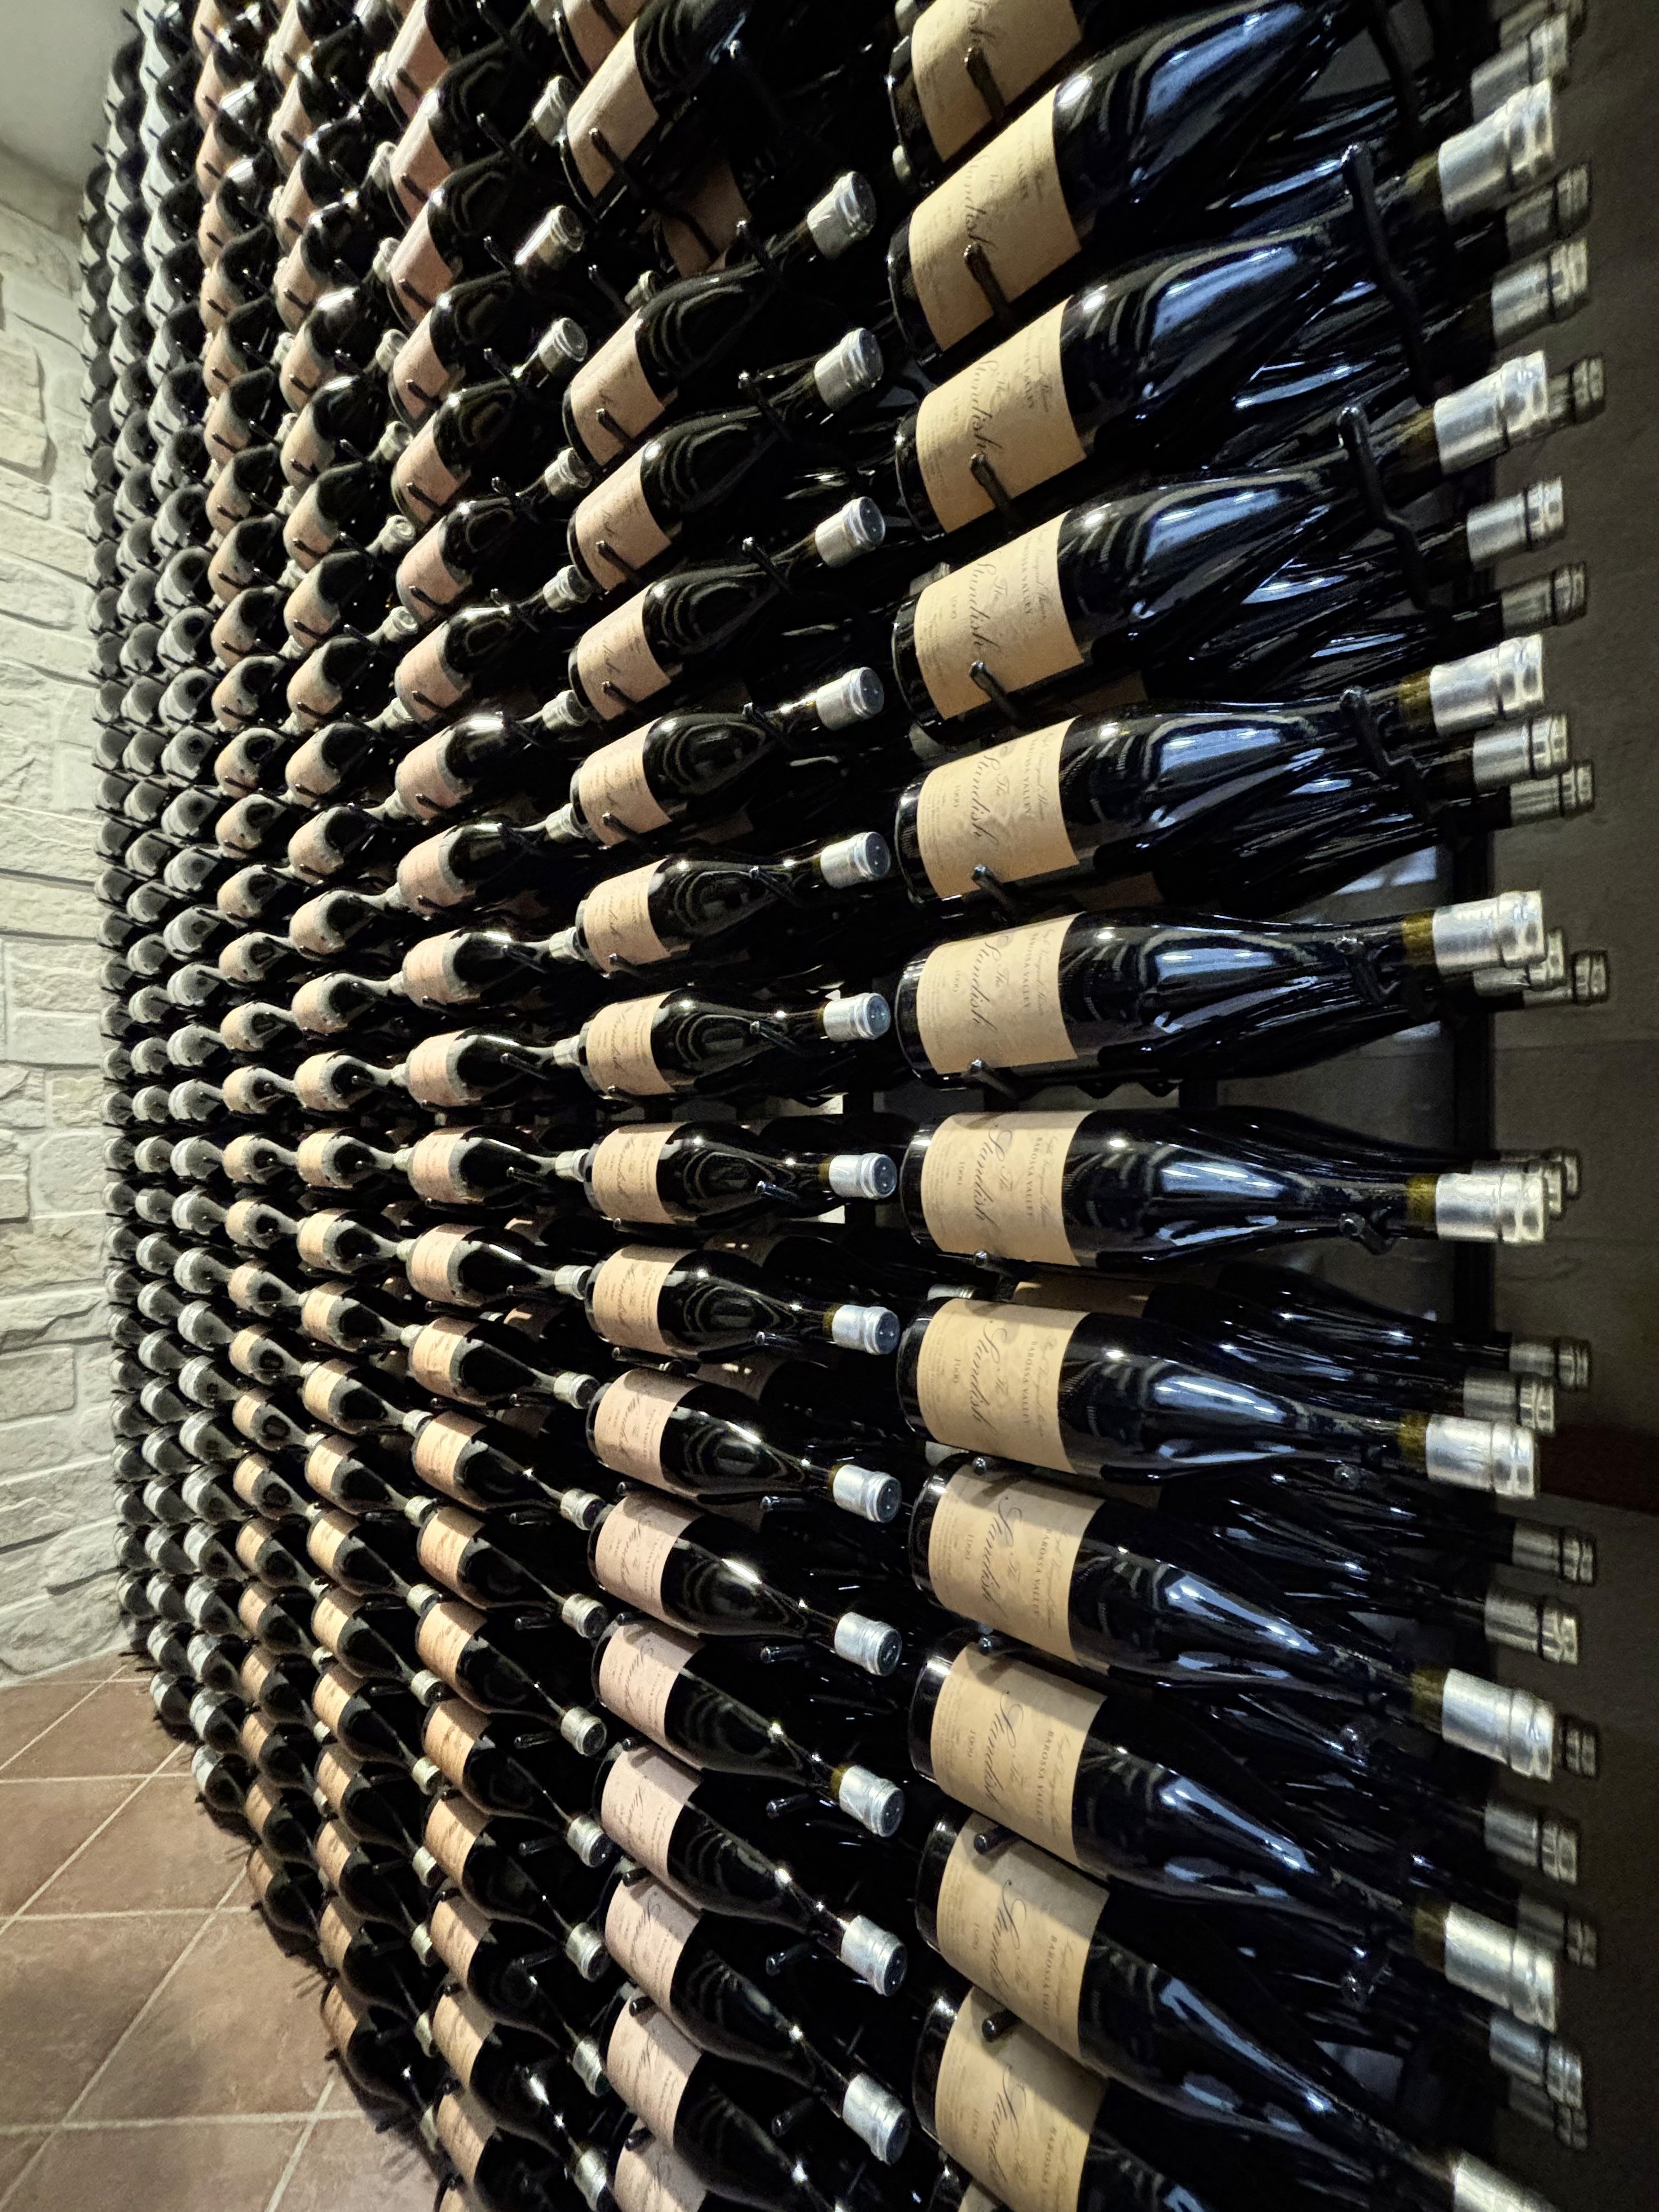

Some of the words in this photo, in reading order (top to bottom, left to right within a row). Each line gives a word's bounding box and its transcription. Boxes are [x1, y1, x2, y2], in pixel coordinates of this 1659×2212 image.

[968, 560, 1001, 650] Standish
[970, 747, 1011, 841] Standish
[969, 935, 1009, 1030] Standish
[995, 965, 1010, 988] The
[973, 1125, 1013, 1229] Standish
[999, 1166, 1013, 1191] The
[1027, 1138, 1042, 1176] BAROSSA
[969, 1321, 1008, 1434] Standish
[1023, 1341, 1037, 1384] BAROSSA
[981, 1496, 1022, 1619] Standish
[1035, 1529, 1052, 1573] BAROSSA
[983, 1690, 1024, 1816] Standish
[1037, 1730, 1054, 1779] BAROSSA
[1042, 1935, 1058, 1989] BAROSSA
[988, 2065, 1026, 2194] Stand
